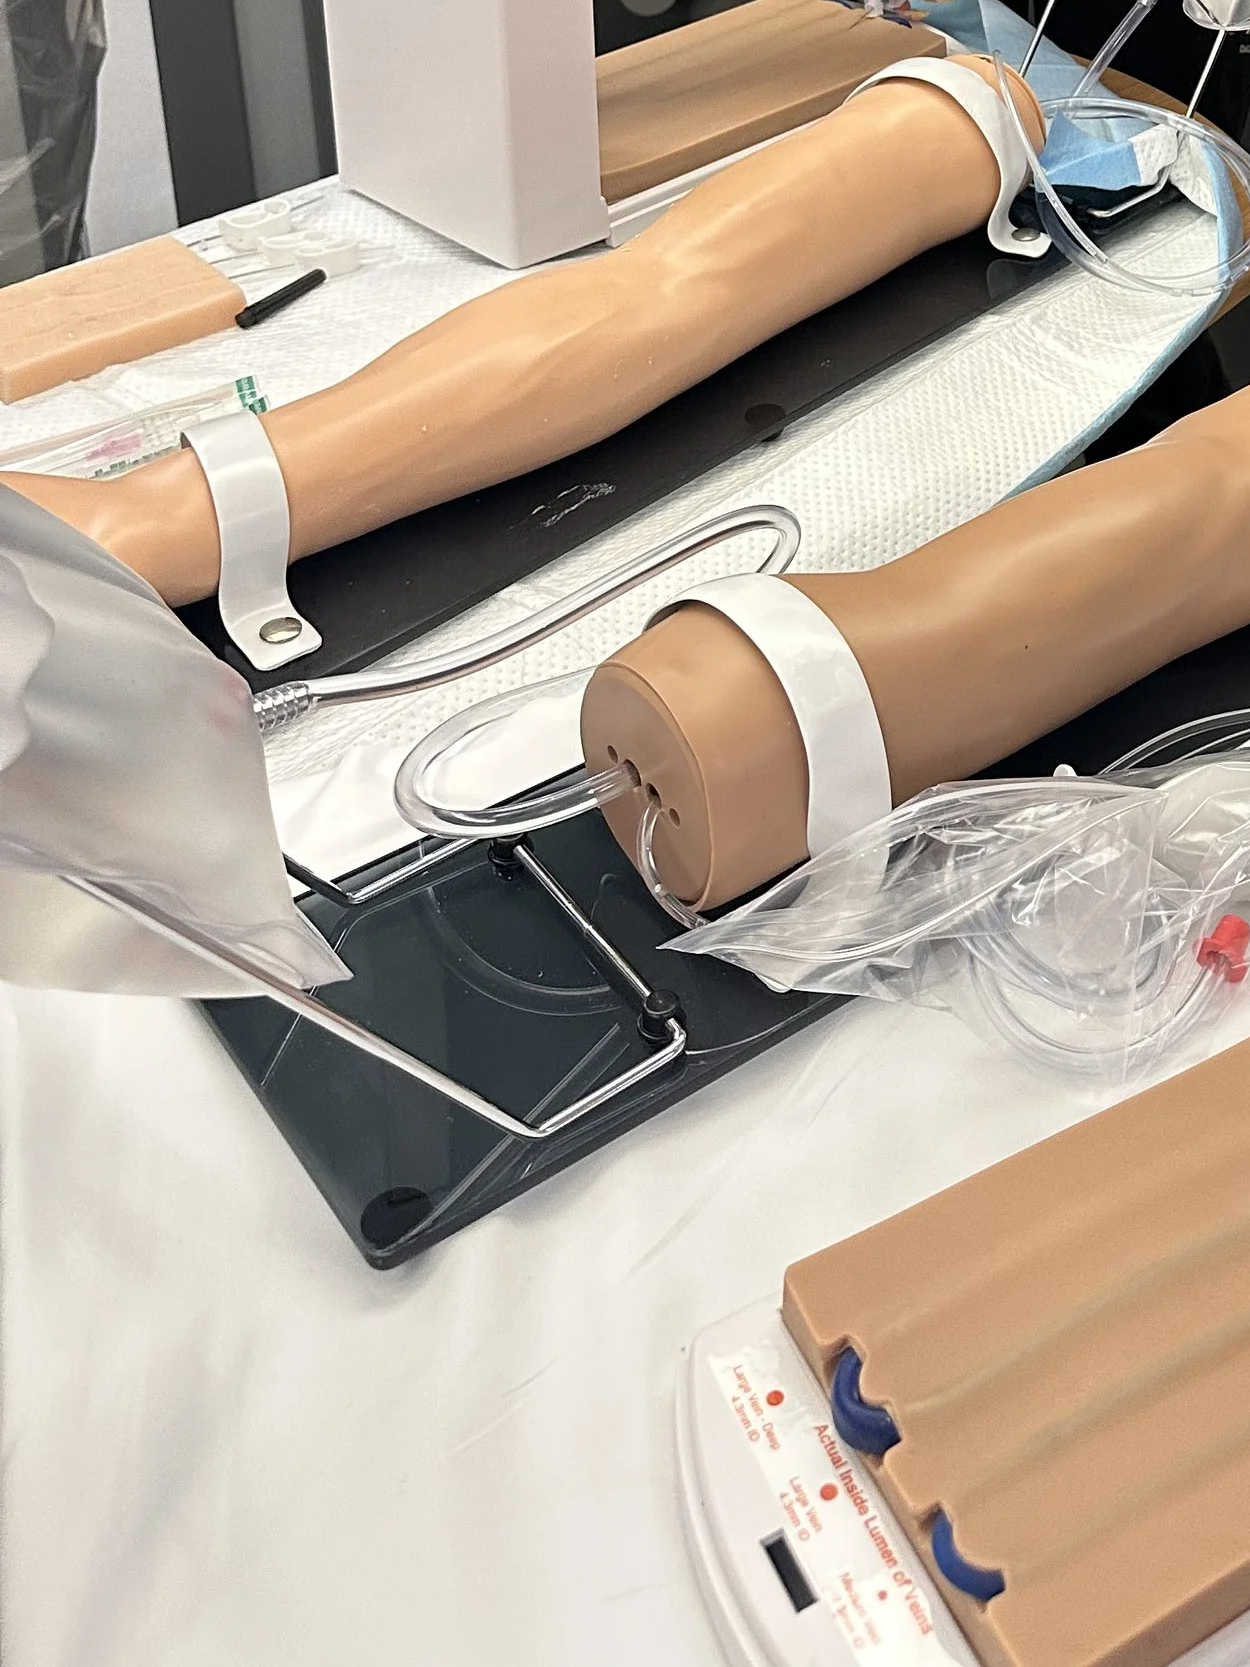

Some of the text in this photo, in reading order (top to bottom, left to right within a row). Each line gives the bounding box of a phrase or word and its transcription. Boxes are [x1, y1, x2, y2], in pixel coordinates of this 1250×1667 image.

[813, 1423, 934, 1637] Actual Inside Lumen of Veins
